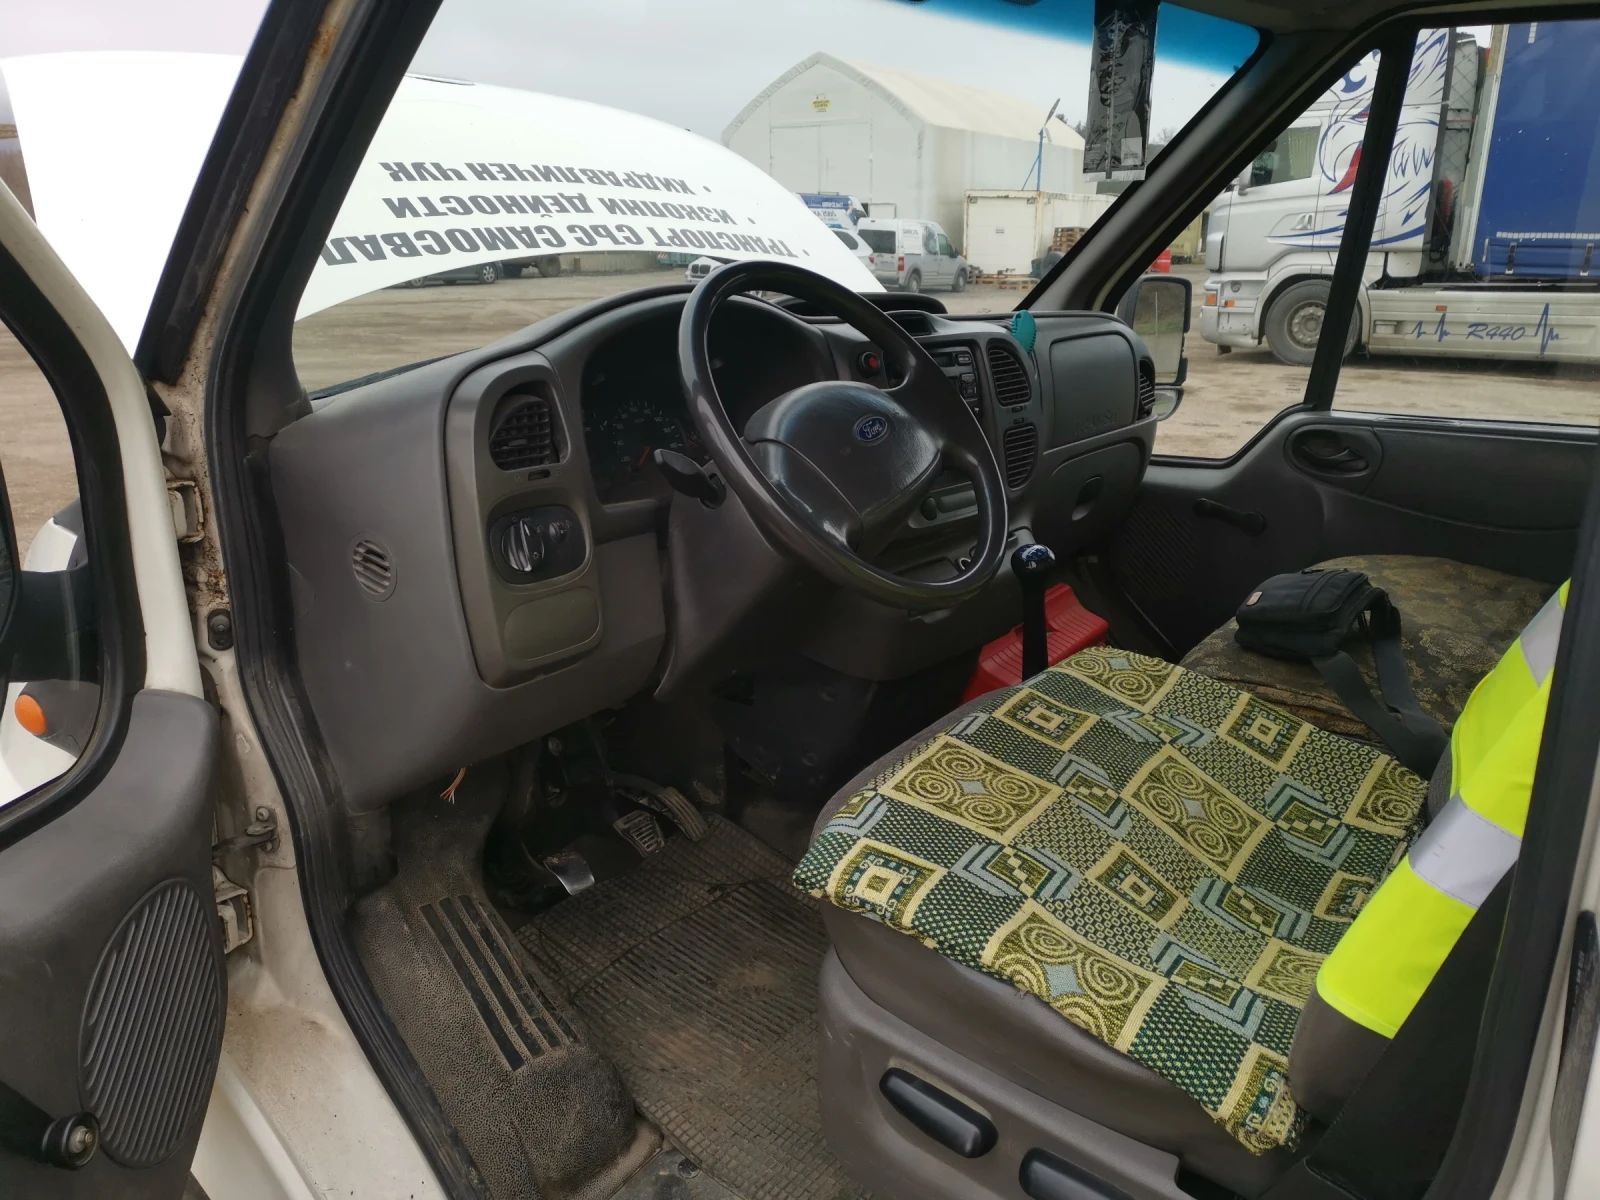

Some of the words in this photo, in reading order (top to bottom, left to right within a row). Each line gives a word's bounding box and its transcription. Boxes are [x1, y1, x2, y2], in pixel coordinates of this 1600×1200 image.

[378, 161, 468, 182] ЧУК
[464, 162, 697, 195] ХИДРАВЛИЧЕН
[382, 192, 594, 218] ДЕЙНОСТИ
[597, 197, 738, 225] ИЗКОПНИ
[320, 224, 567, 266] САМОСВАЛ
[566, 224, 644, 247] СЪС
[646, 226, 799, 258] ТРАНСПОРТ
[1466, 322, 1526, 341] R440
[862, 420, 883, 439] Ford
